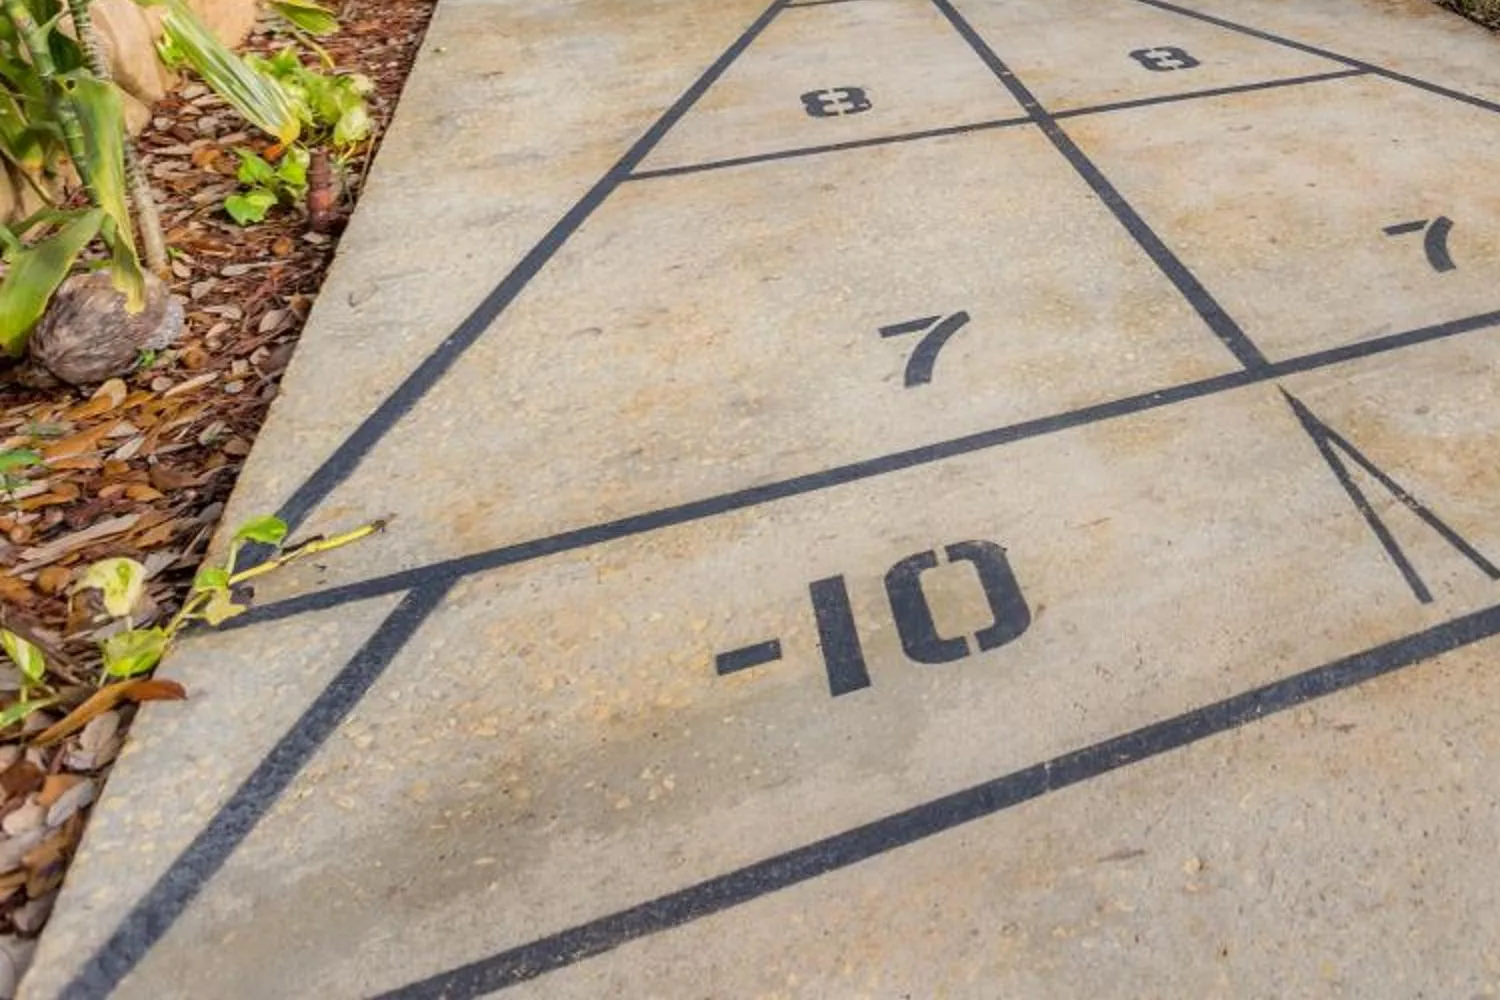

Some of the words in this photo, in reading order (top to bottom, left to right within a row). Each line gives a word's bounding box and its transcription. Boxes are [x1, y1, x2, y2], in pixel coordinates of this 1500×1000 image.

[1129, 46, 1200, 72] 8
[800, 86, 872, 117] 8
[1383, 216, 1456, 272] 7
[879, 311, 970, 387] 7
[715, 540, 1032, 697] -10
